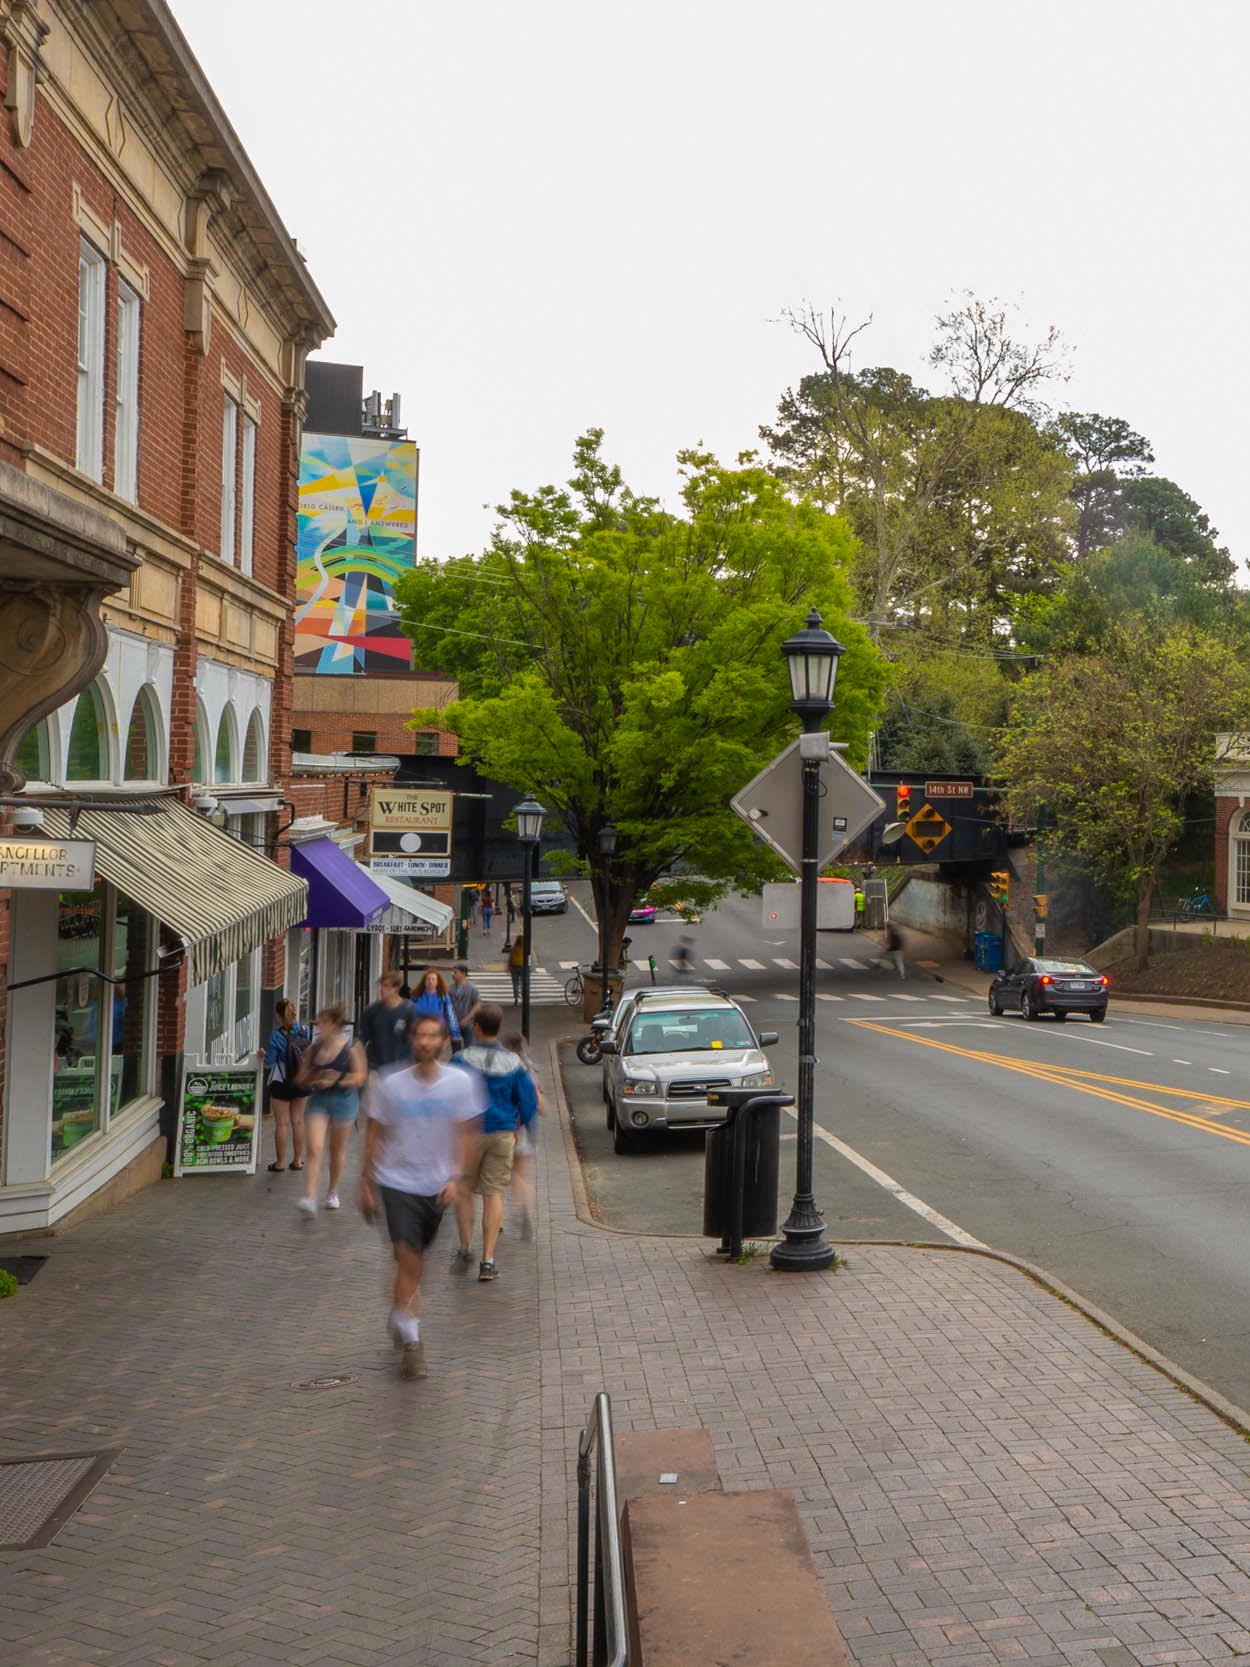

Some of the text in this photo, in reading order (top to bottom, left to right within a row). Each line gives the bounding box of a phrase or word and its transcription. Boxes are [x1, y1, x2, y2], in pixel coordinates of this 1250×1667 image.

[929, 785, 945, 794] 14th
[947, 785, 955, 794] St
[378, 801, 447, 816] WHITE SPOT
[384, 815, 438, 825] RESTAURANT
[373, 861, 404, 869] BREAKFAST
[407, 861, 425, 869] LUNCH
[183, 1110, 197, 1165] 100% ORGANIC
